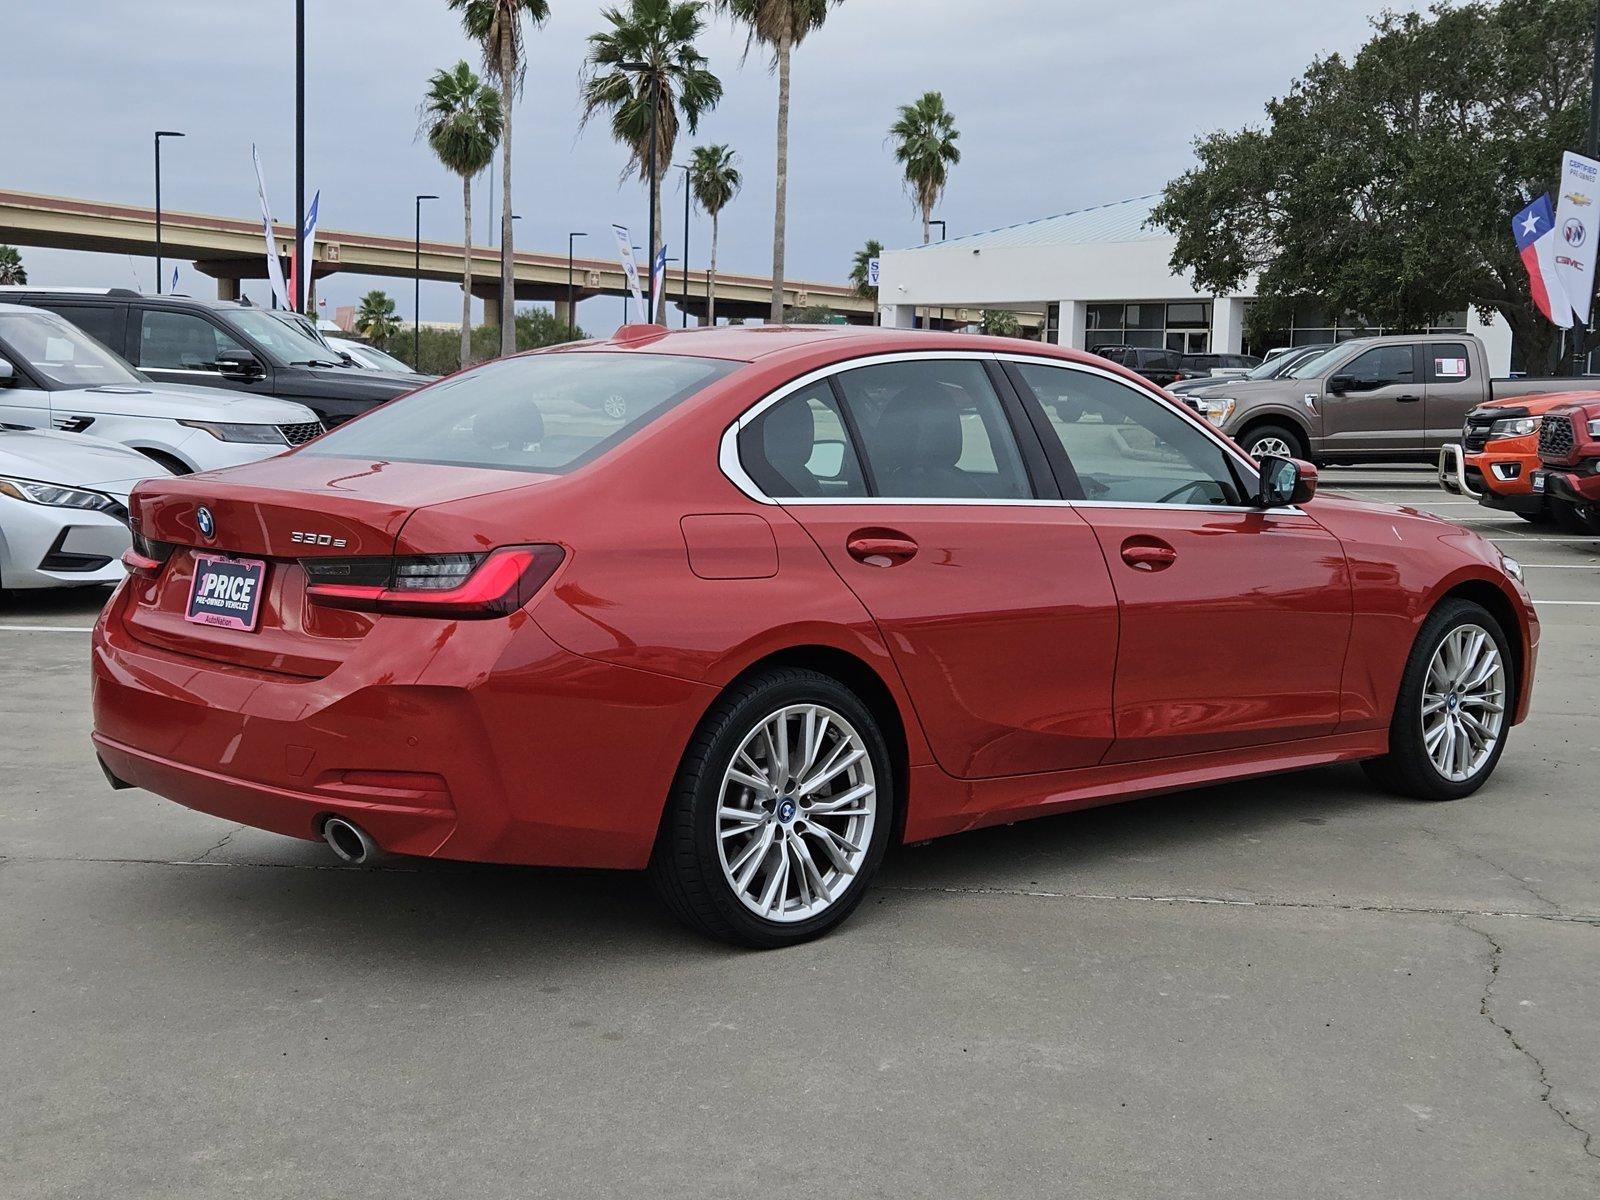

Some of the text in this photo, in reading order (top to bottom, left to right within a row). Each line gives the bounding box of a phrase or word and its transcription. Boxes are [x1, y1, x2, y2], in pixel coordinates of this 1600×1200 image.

[1569, 160, 1597, 174] CERTIFIED
[1555, 256, 1584, 271] GMC
[196, 596, 249, 610] PRE-OWNED VEHICLES
[205, 616, 231, 626] AutoNation
